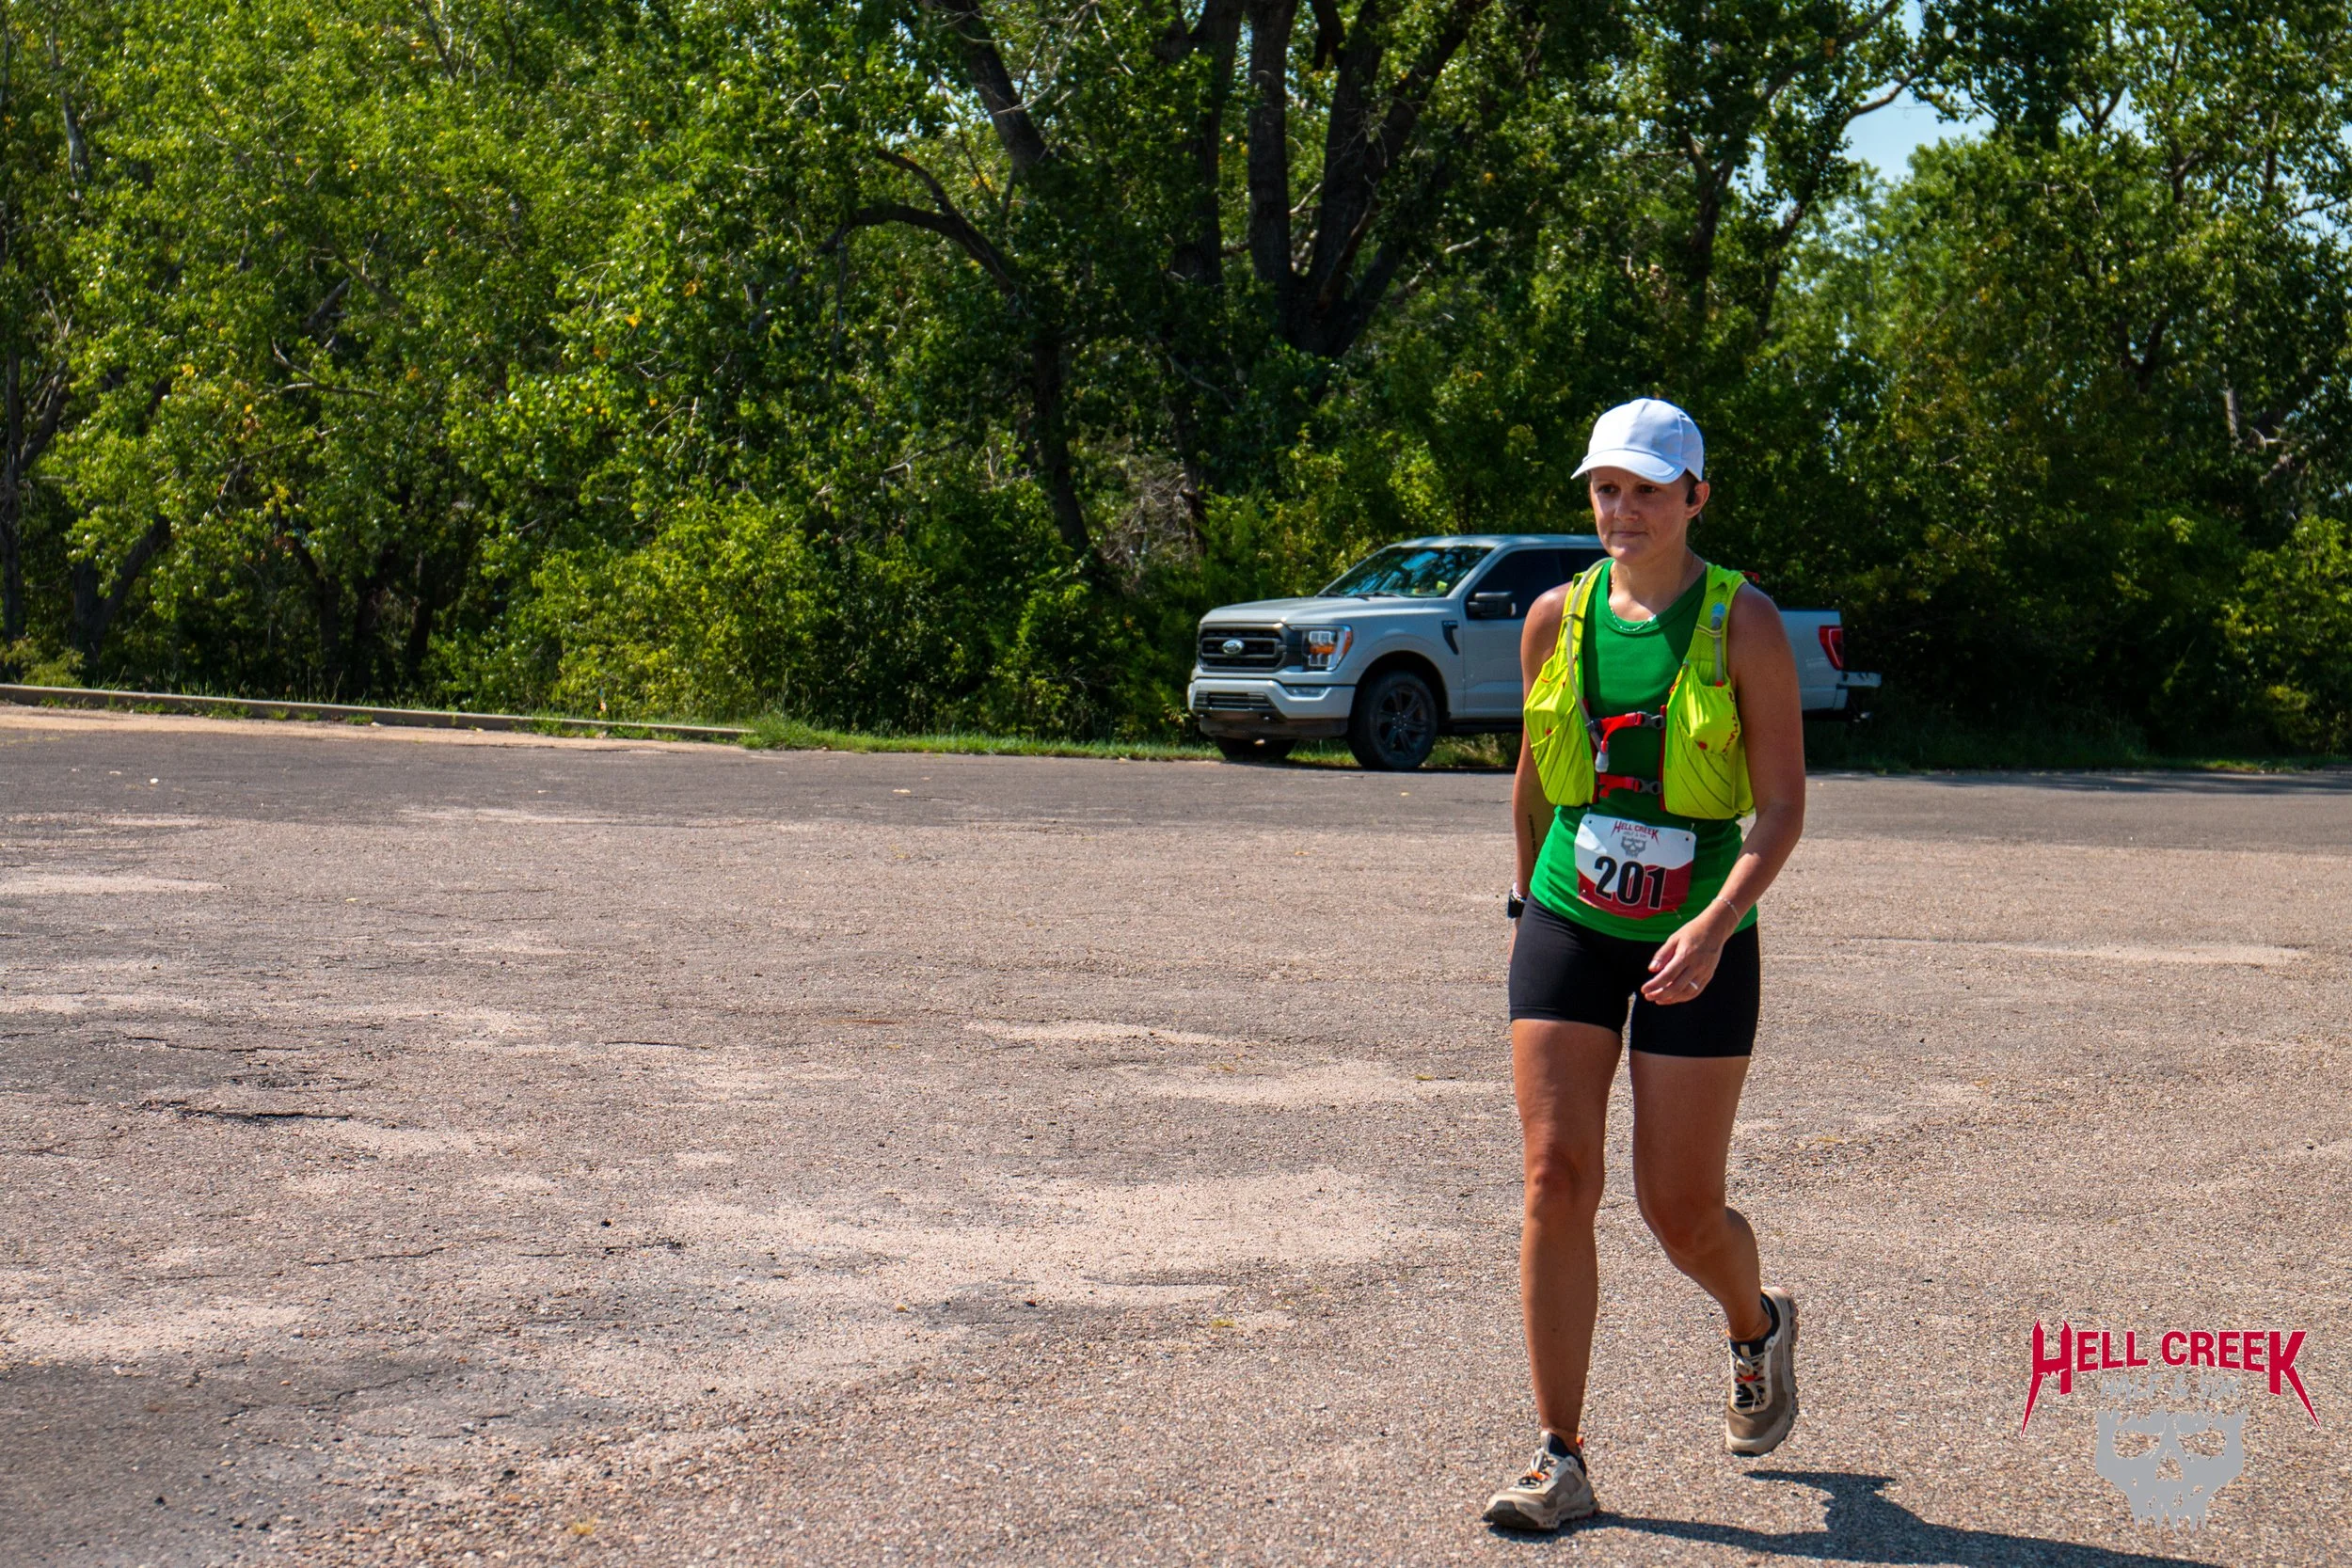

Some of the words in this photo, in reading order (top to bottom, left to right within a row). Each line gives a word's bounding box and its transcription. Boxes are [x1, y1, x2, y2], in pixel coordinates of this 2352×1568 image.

[1610, 819, 1633, 836] HELL
[1634, 824, 1661, 847] CREEK
[1594, 856, 1666, 910] 201
